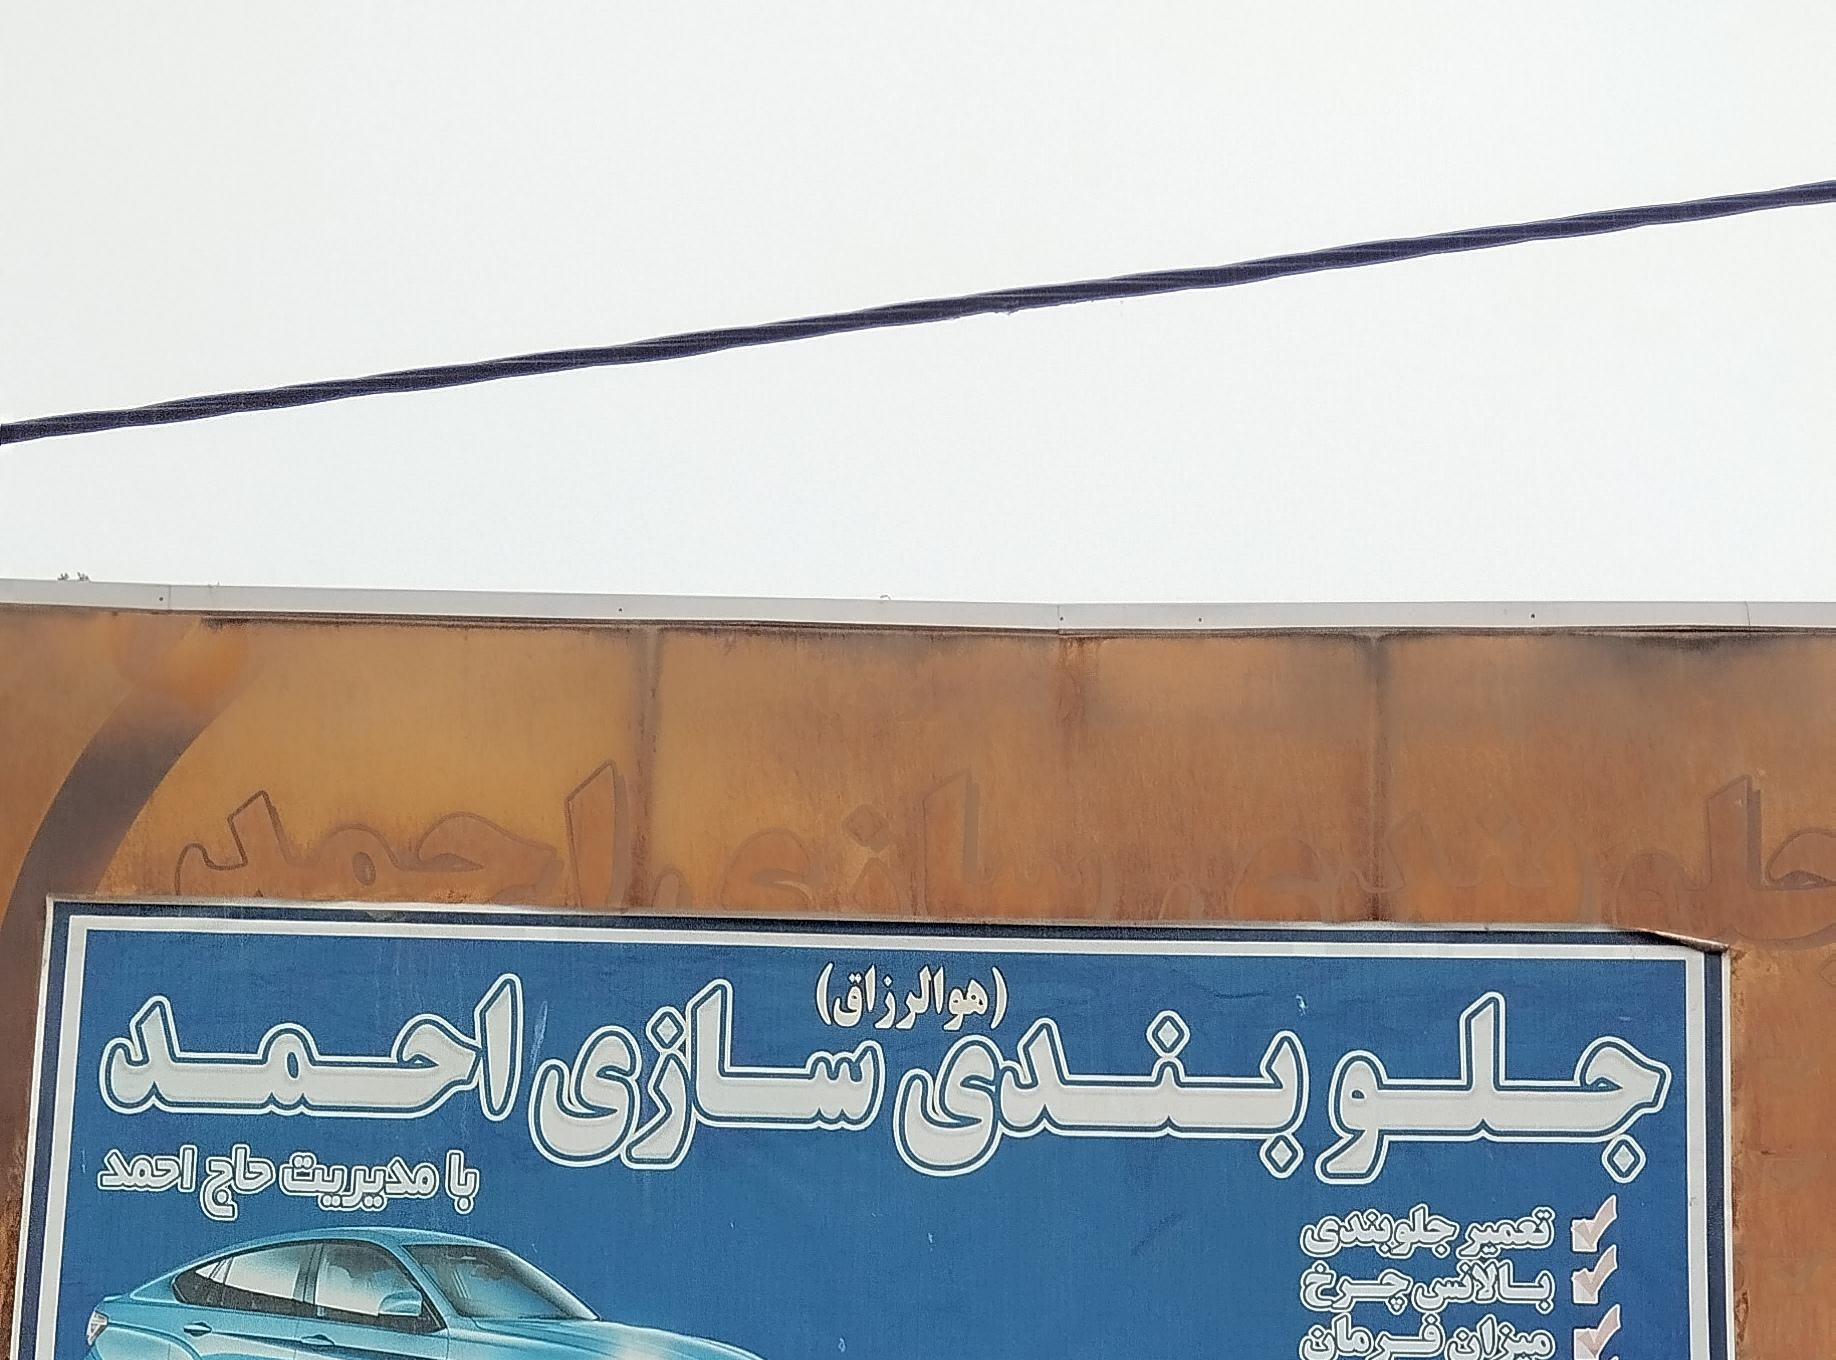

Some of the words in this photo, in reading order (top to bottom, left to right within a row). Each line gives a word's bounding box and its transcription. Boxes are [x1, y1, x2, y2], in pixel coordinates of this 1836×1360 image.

[98, 973, 525, 1121] احمد
[529, 978, 886, 1169] سازی
[97, 1144, 197, 1193] احمد
[200, 1142, 276, 1221] حاج
[279, 1151, 440, 1212] مدیریت
[445, 1150, 480, 1214] با
[1300, 1203, 1459, 1258] جلوبندی
[1457, 1206, 1556, 1258] تعمیر
[1300, 1261, 1412, 1314] چرخ
[1412, 1258, 1556, 1313] بالانس
